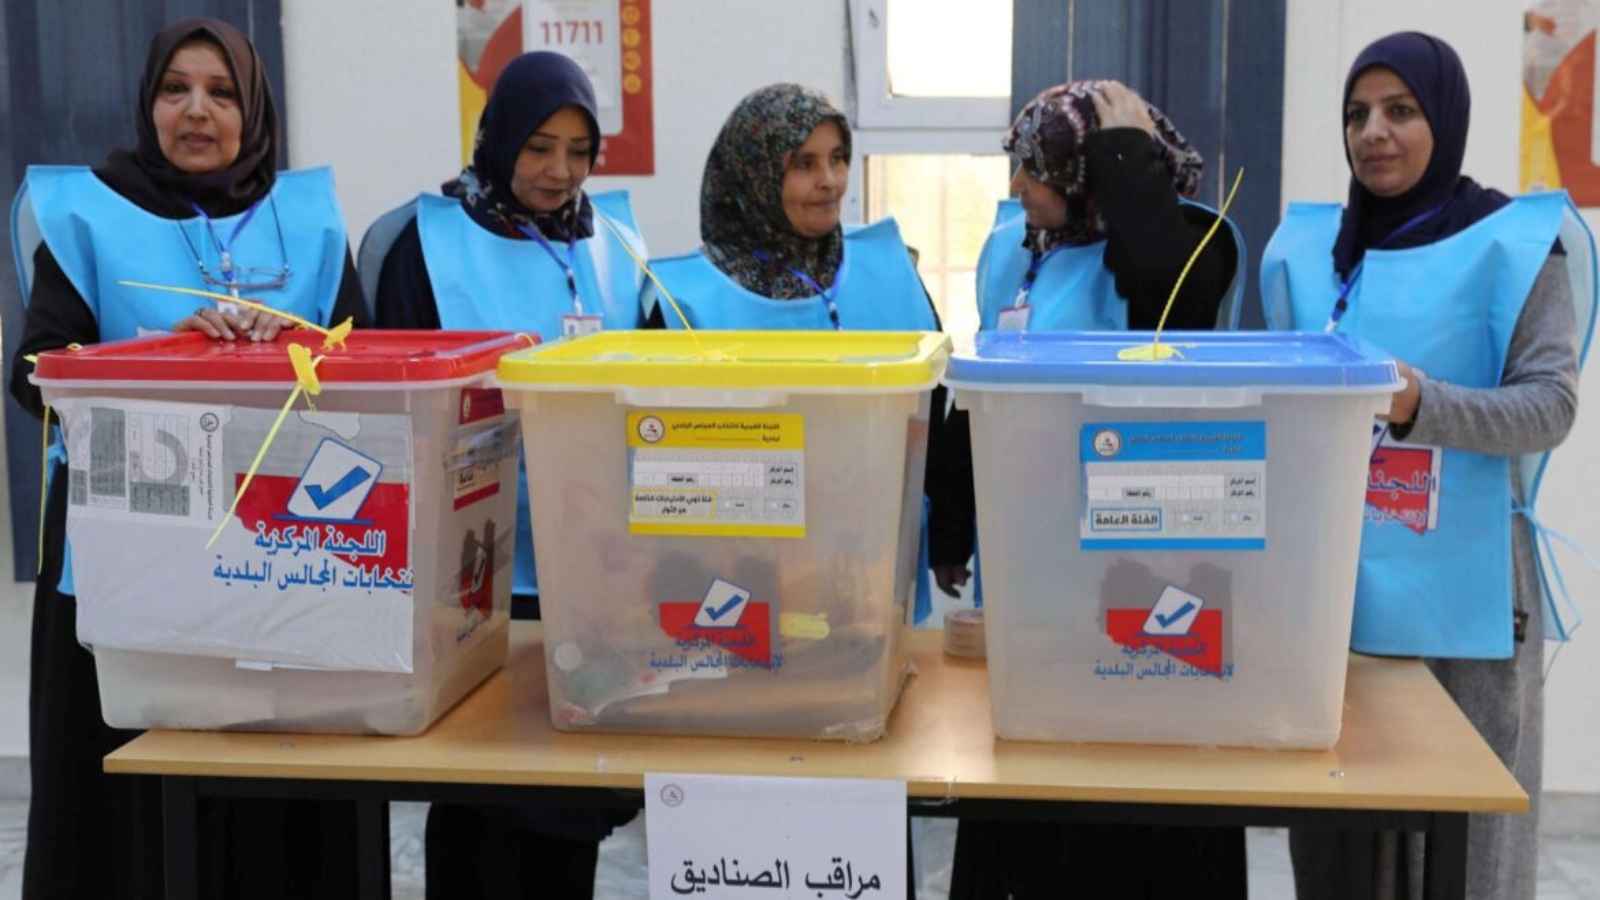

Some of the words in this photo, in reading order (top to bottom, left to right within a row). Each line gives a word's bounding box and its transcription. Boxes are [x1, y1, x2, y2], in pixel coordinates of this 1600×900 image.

[540, 20, 603, 45] 11711
[1367, 469, 1436, 501] اللجن
[254, 521, 320, 556] المركزية
[324, 525, 386, 561] اللجنة
[213, 554, 272, 589] البلدية
[277, 559, 337, 592] المجالس
[342, 566, 416, 594] نتخابات
[670, 857, 790, 895] الصناديق
[804, 856, 882, 900] مراقب
